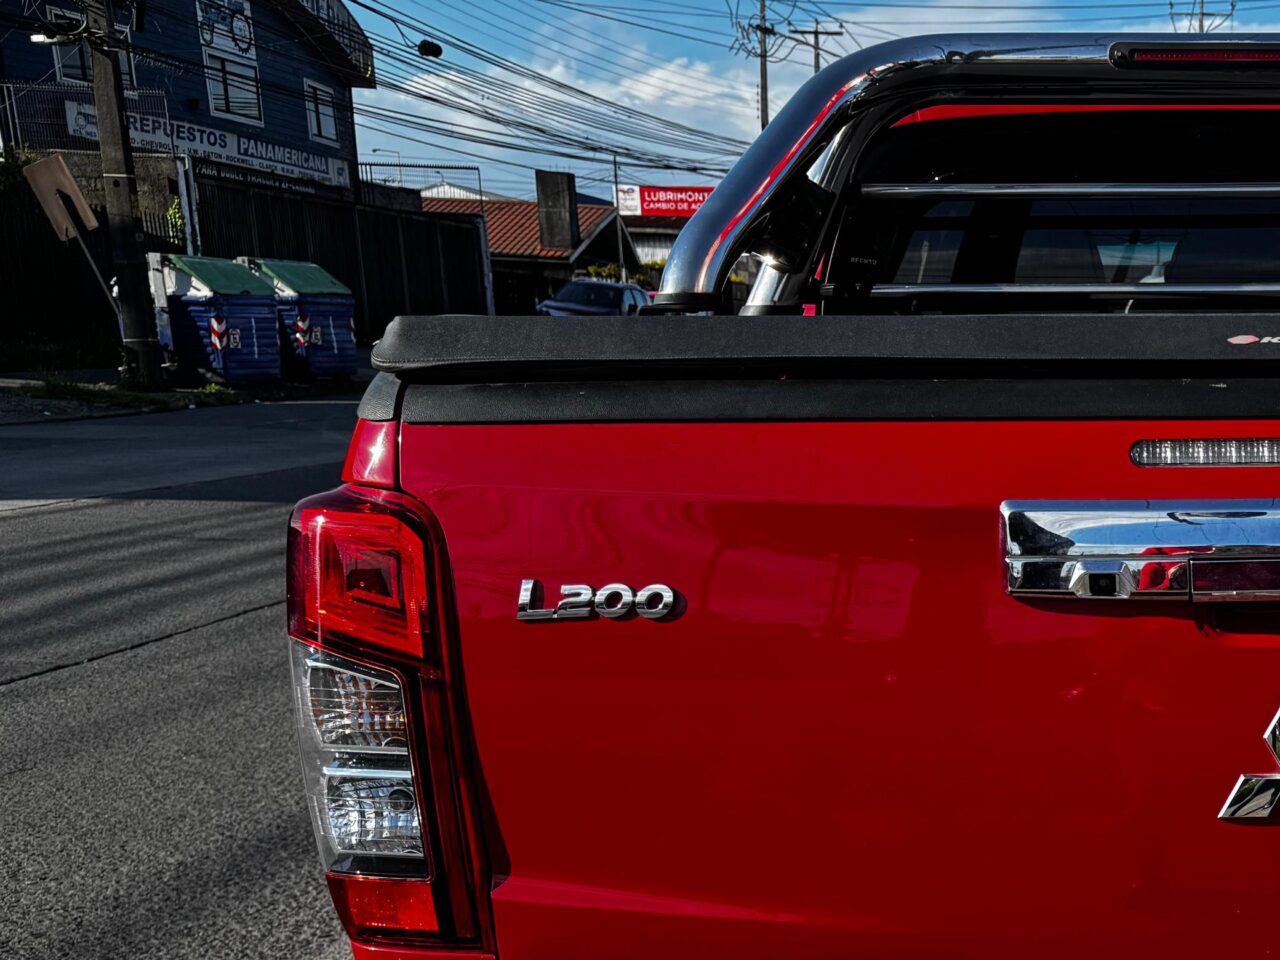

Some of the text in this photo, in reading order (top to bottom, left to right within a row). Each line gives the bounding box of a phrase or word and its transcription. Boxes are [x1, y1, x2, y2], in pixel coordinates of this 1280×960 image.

[128, 113, 329, 173] REPUESTOS PANAMERICANA
[643, 201, 676, 210] CAMBIO
[677, 202, 689, 210] DE
[516, 578, 674, 620] L200
